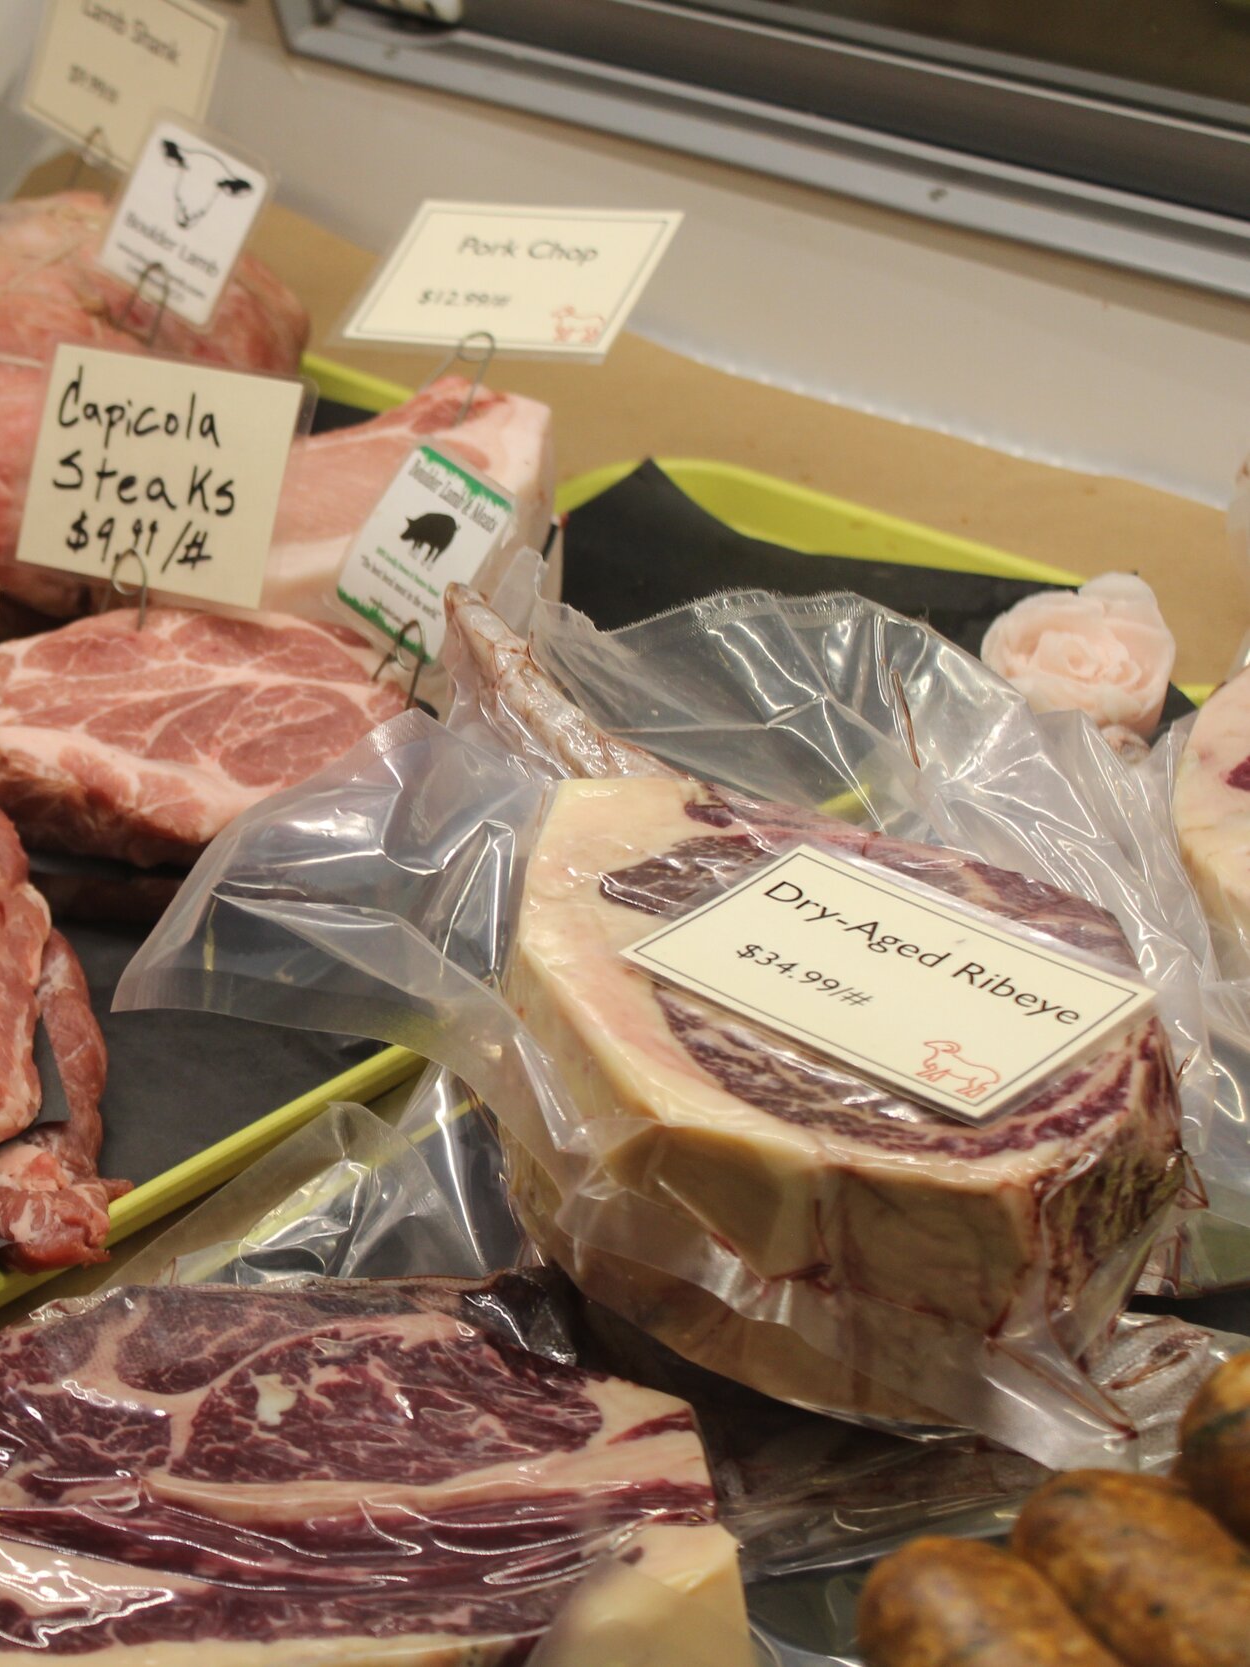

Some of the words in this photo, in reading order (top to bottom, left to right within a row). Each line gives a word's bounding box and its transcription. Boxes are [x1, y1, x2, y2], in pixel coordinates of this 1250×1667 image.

[458, 235, 516, 259] Pork
[528, 239, 599, 267] Chop
[58, 364, 221, 450] Capicola
[736, 942, 875, 1008] $34.99/#
[763, 880, 952, 969] Dry-Aged
[951, 961, 1081, 1026] Ribeye
